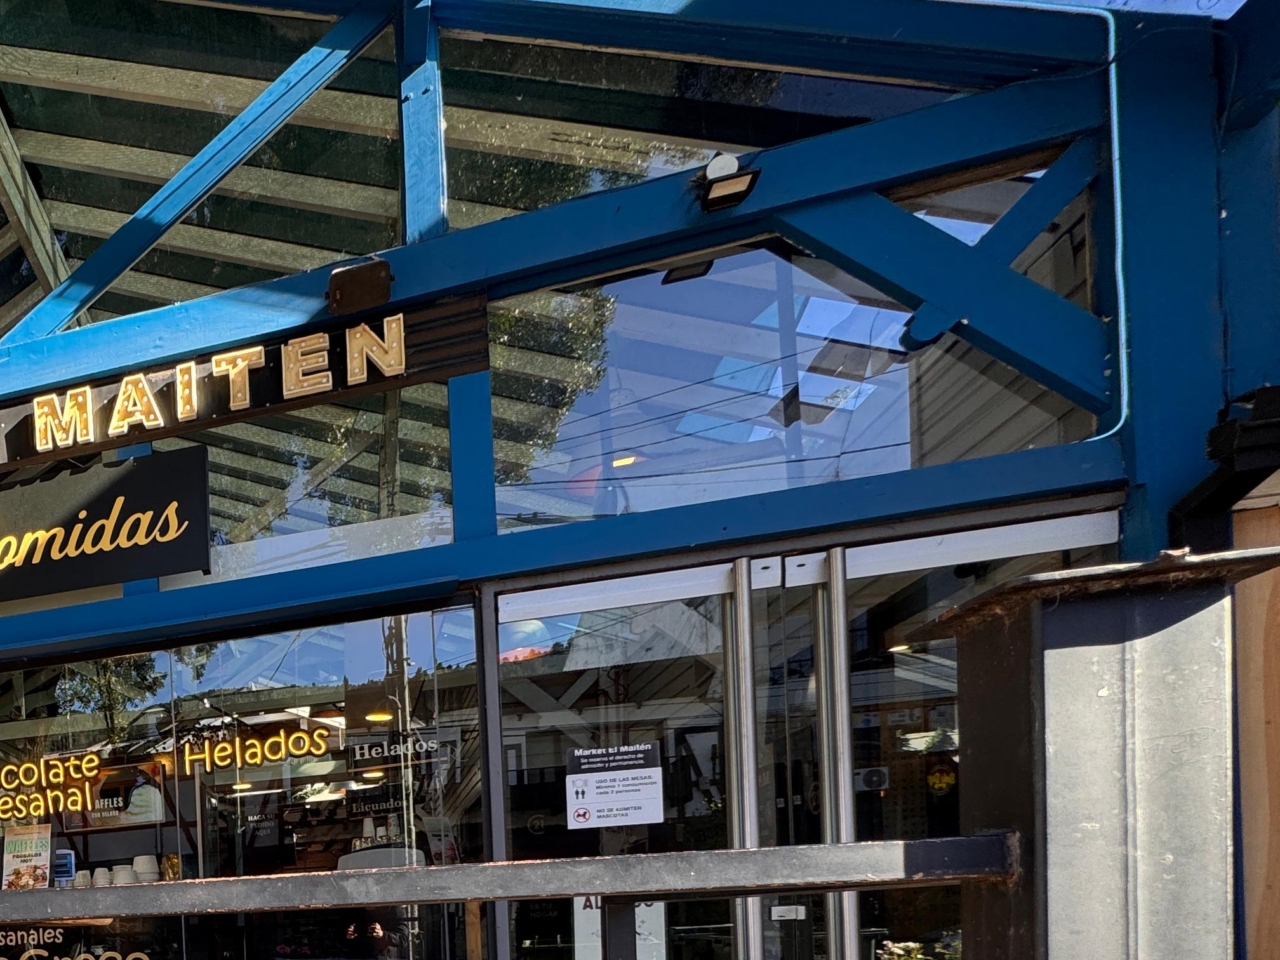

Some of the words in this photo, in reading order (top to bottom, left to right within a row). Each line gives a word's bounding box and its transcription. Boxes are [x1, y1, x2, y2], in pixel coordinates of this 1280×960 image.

[32, 312, 408, 453] MAITEN
[183, 727, 330, 776] Helados
[353, 739, 439, 761] Helados
[574, 748, 606, 756] Market
[95, 797, 124, 809] AFFLES
[6, 838, 49, 854] WAFFLES
